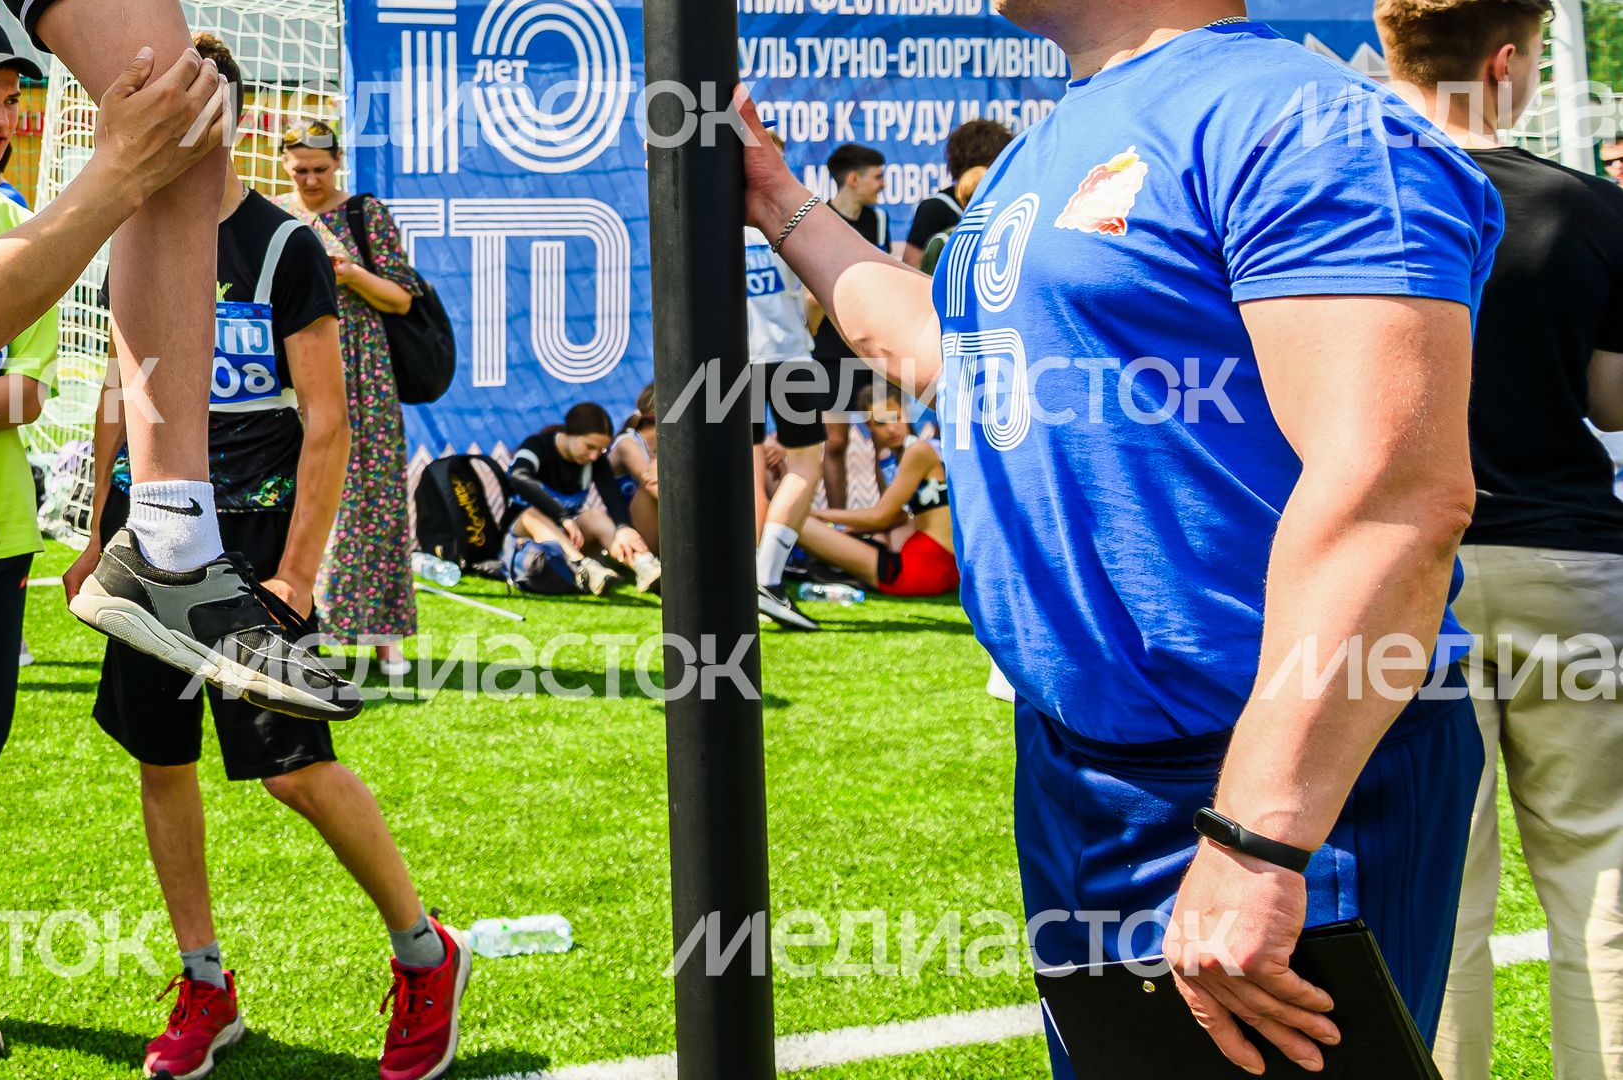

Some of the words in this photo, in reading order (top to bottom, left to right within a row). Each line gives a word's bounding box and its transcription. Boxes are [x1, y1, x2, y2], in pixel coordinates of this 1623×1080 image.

[473, 58, 529, 83] лет
[834, 100, 856, 142] К
[859, 100, 955, 145] ТРУДУ
[945, 192, 1040, 318] 10
[746, 270, 775, 294] 07
[210, 356, 275, 398] 08
